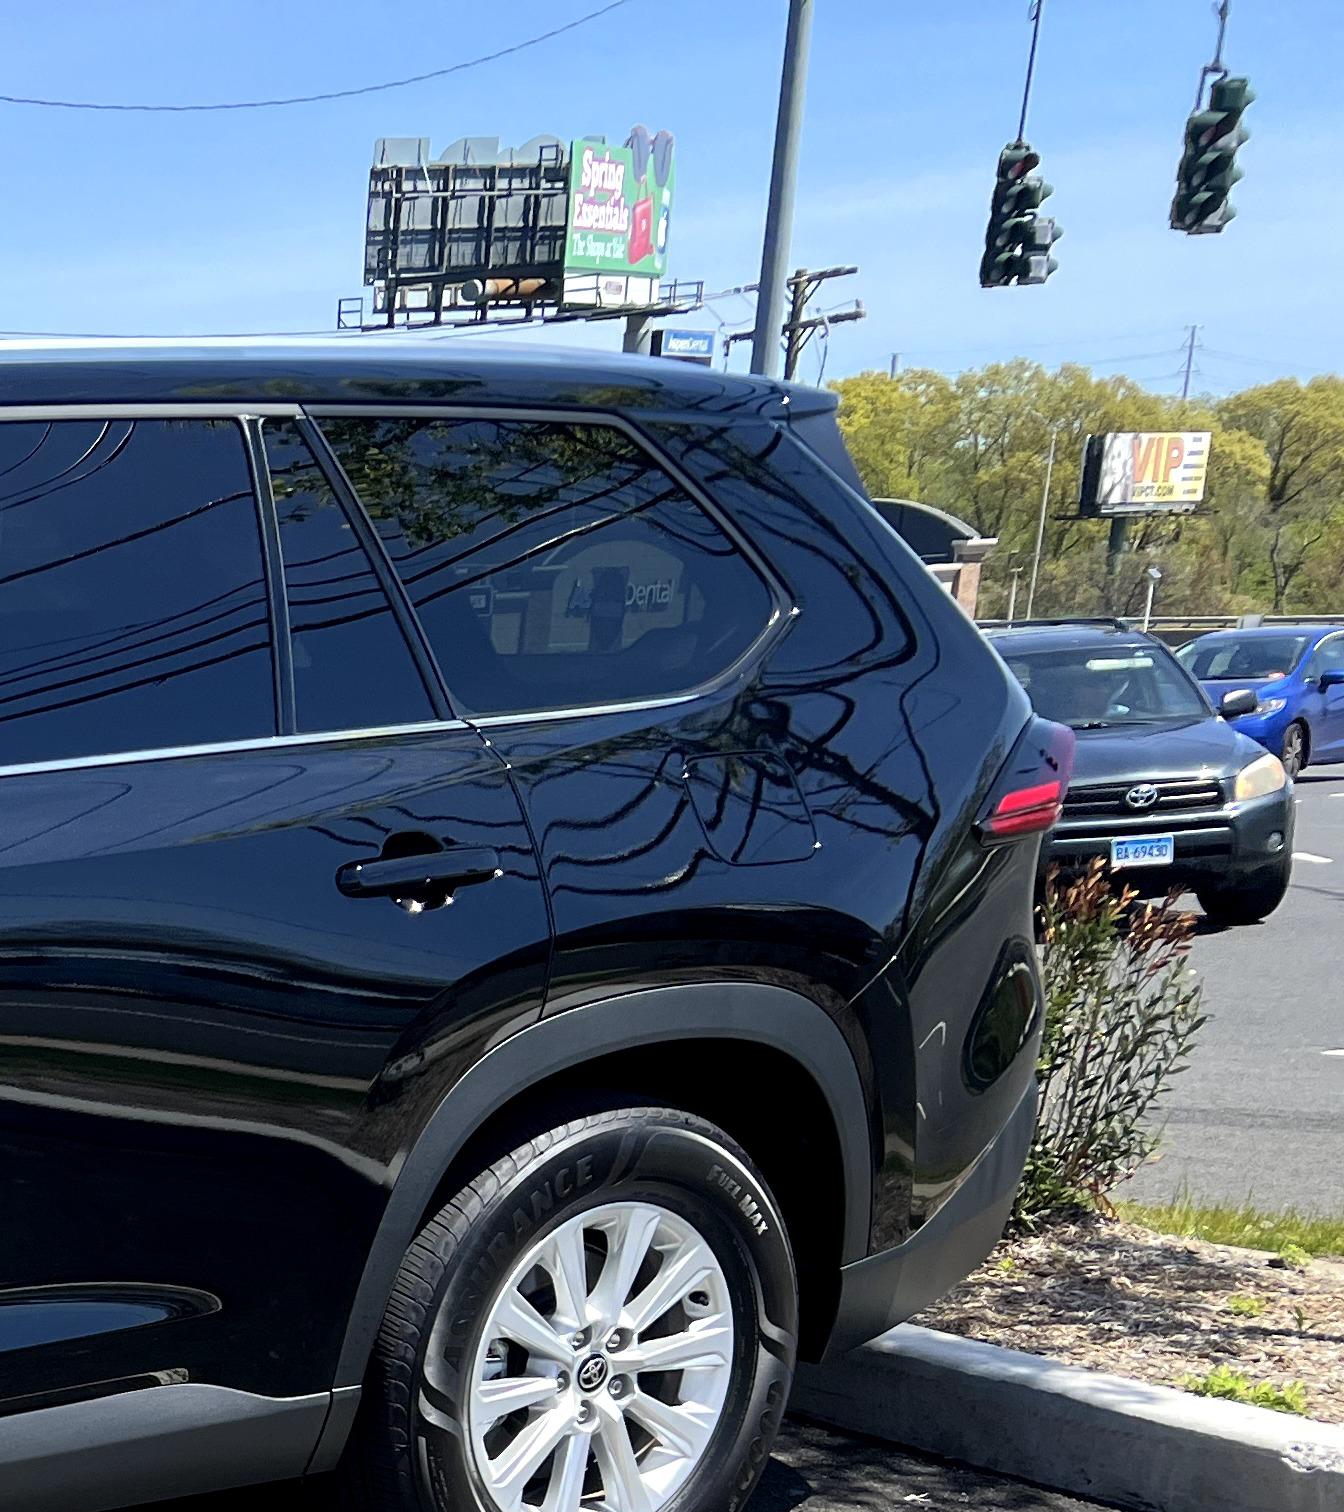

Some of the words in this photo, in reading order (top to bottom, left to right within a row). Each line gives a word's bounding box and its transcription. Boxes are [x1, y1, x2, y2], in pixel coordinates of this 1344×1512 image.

[581, 149, 625, 198] Spring
[573, 193, 628, 231] Essentials
[1132, 436, 1185, 483] VIP
[705, 1163, 742, 1200] FUEL
[737, 1193, 769, 1236] MAX
